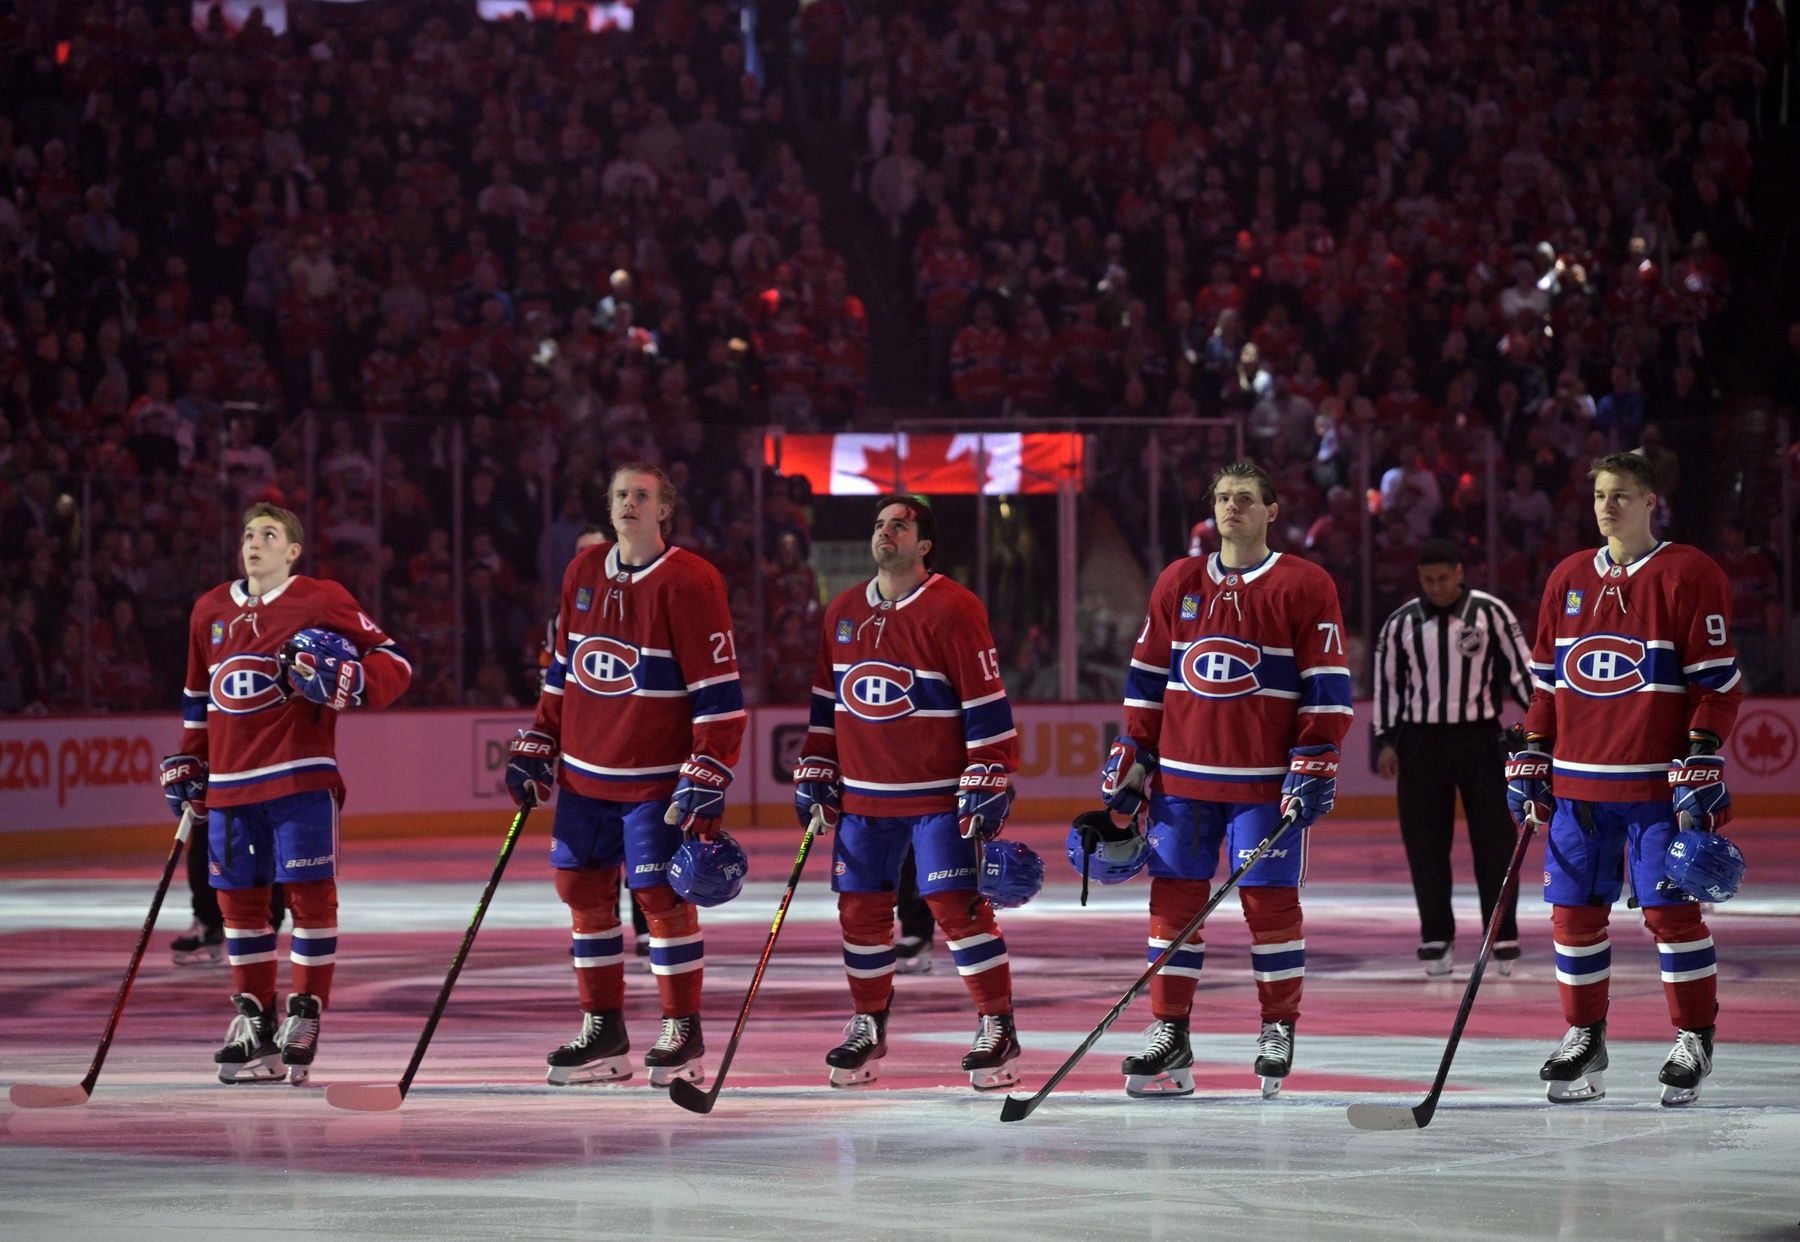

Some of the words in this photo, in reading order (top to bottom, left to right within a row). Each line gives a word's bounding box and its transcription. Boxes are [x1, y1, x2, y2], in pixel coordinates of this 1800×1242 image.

[709, 630, 737, 664] 21
[1317, 622, 1343, 656] 71
[1705, 614, 1727, 646] 9
[978, 647, 1000, 681] 15
[59, 735, 154, 808] pizza
[1290, 760, 1338, 772] CCM
